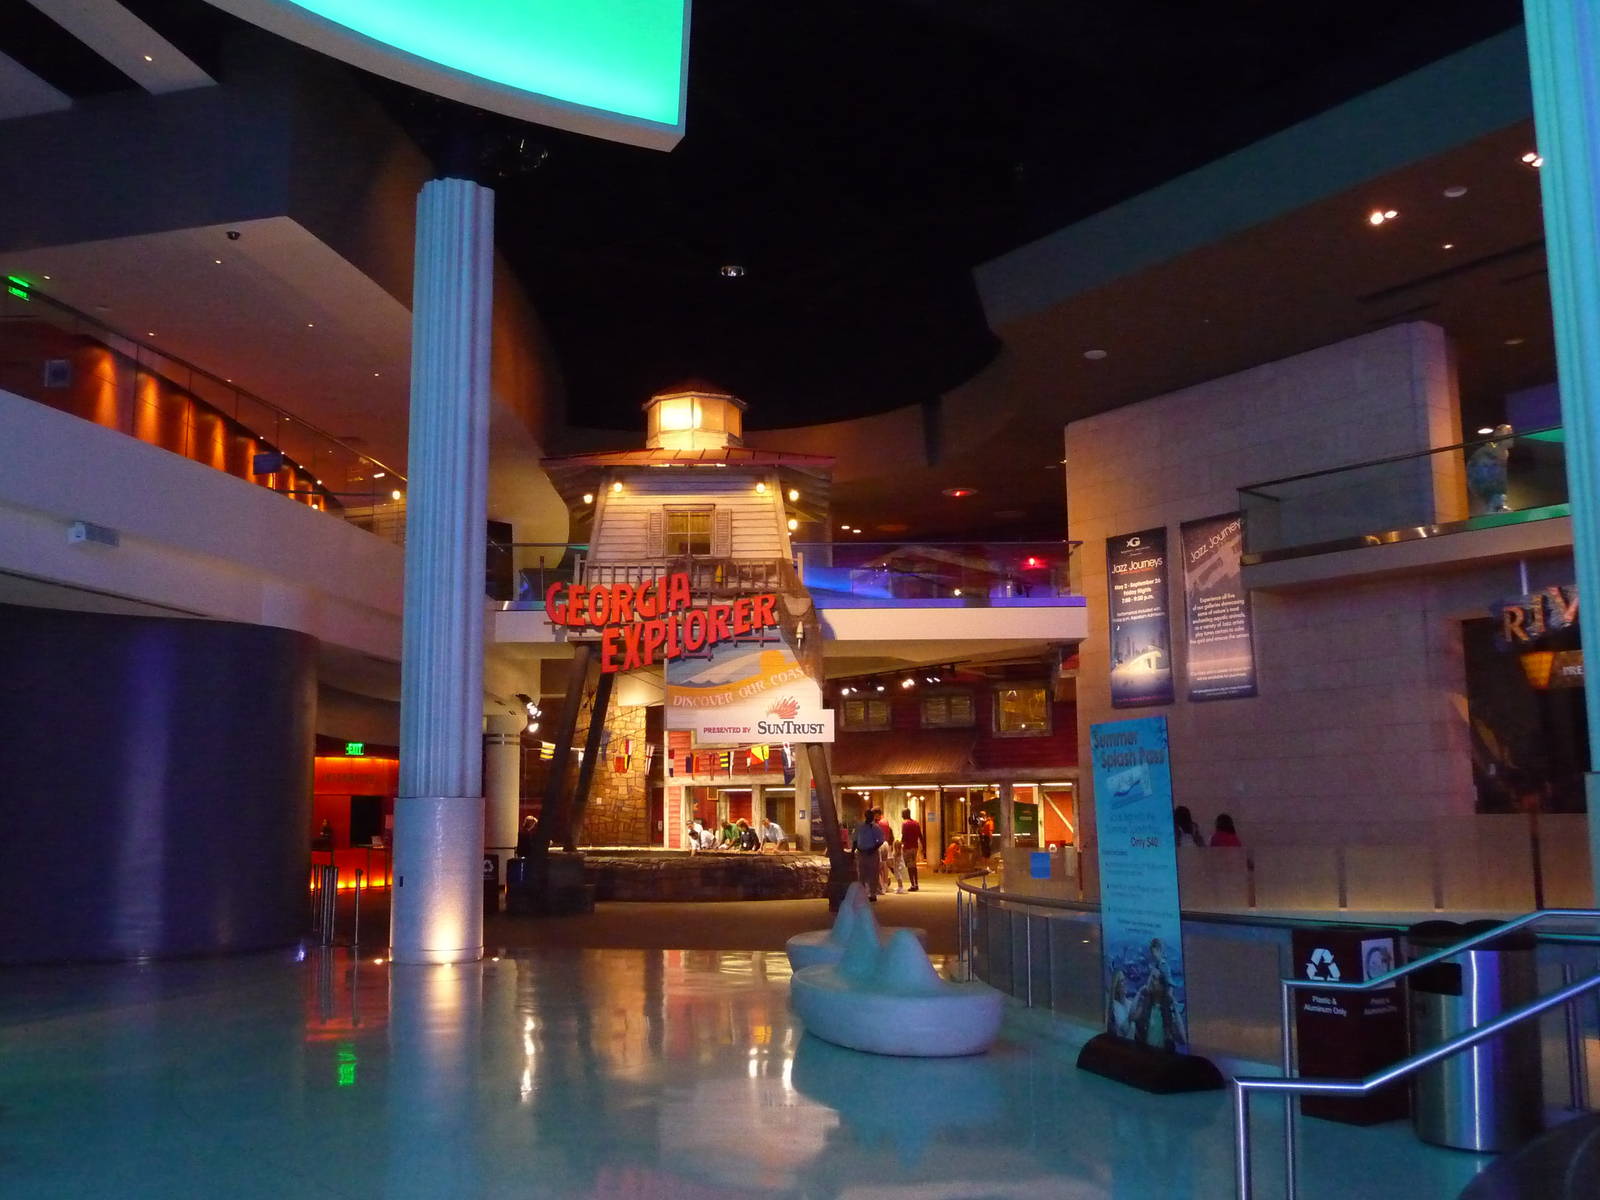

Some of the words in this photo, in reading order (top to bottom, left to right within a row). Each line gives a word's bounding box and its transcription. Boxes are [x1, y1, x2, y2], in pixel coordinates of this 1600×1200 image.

[1190, 544, 1208, 562] Jazz
[1112, 563, 1128, 574] Jazz
[1128, 557, 1163, 570] Journeys
[545, 572, 691, 627] GEORGIA
[601, 593, 778, 673] EXPLORER
[672, 690, 735, 709] DISCOVER
[738, 680, 766, 698] OUR
[348, 743, 362, 755] EXIT
